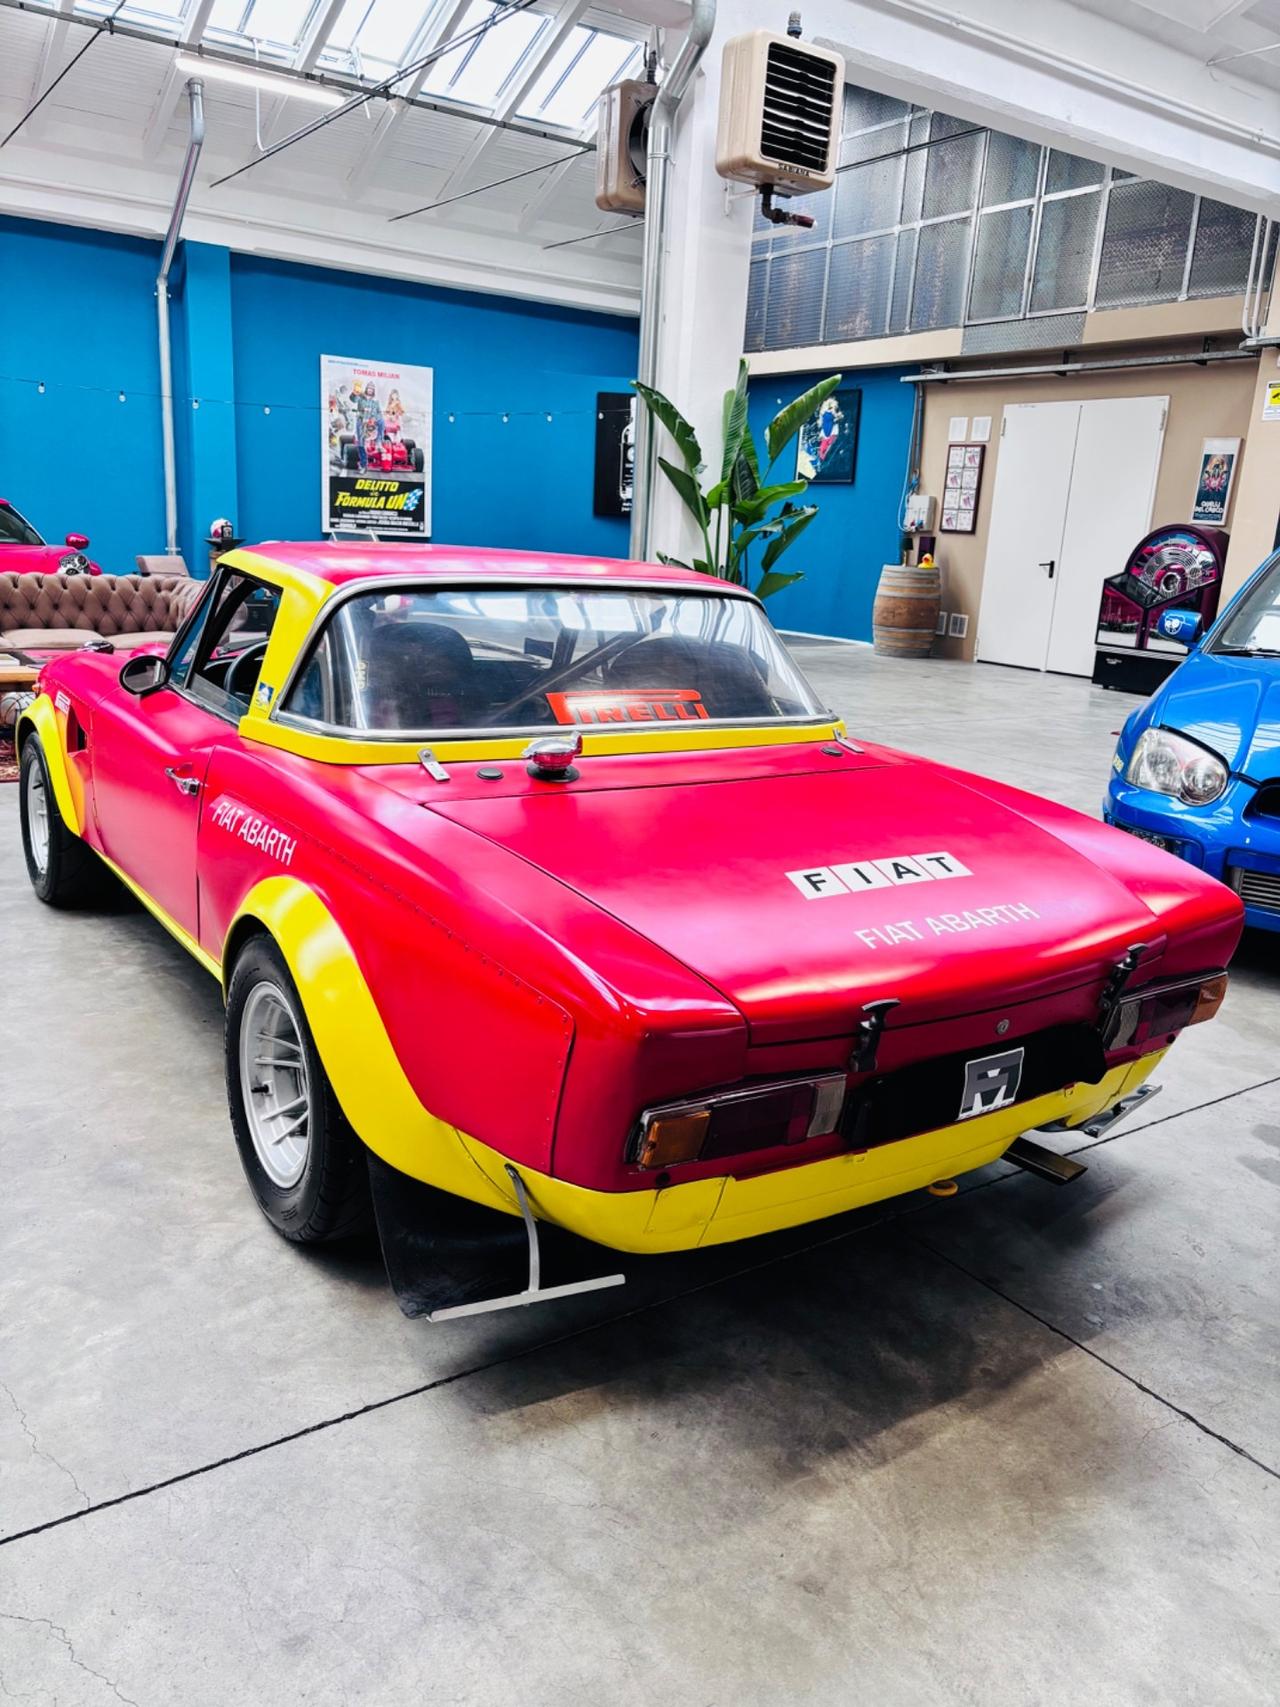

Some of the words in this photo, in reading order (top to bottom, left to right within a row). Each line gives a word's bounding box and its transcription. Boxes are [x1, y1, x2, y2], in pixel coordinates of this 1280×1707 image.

[353, 368, 377, 377] TOMAS
[335, 491, 386, 509] FORMULA
[355, 479, 399, 492] DELITTO
[545, 689, 710, 725] PIRELLI
[211, 801, 245, 833] FIAT
[237, 816, 298, 867] ABARTH
[803, 856, 954, 892] FIAT
[853, 920, 924, 949] FIAT
[924, 902, 1041, 936] ABARTH
